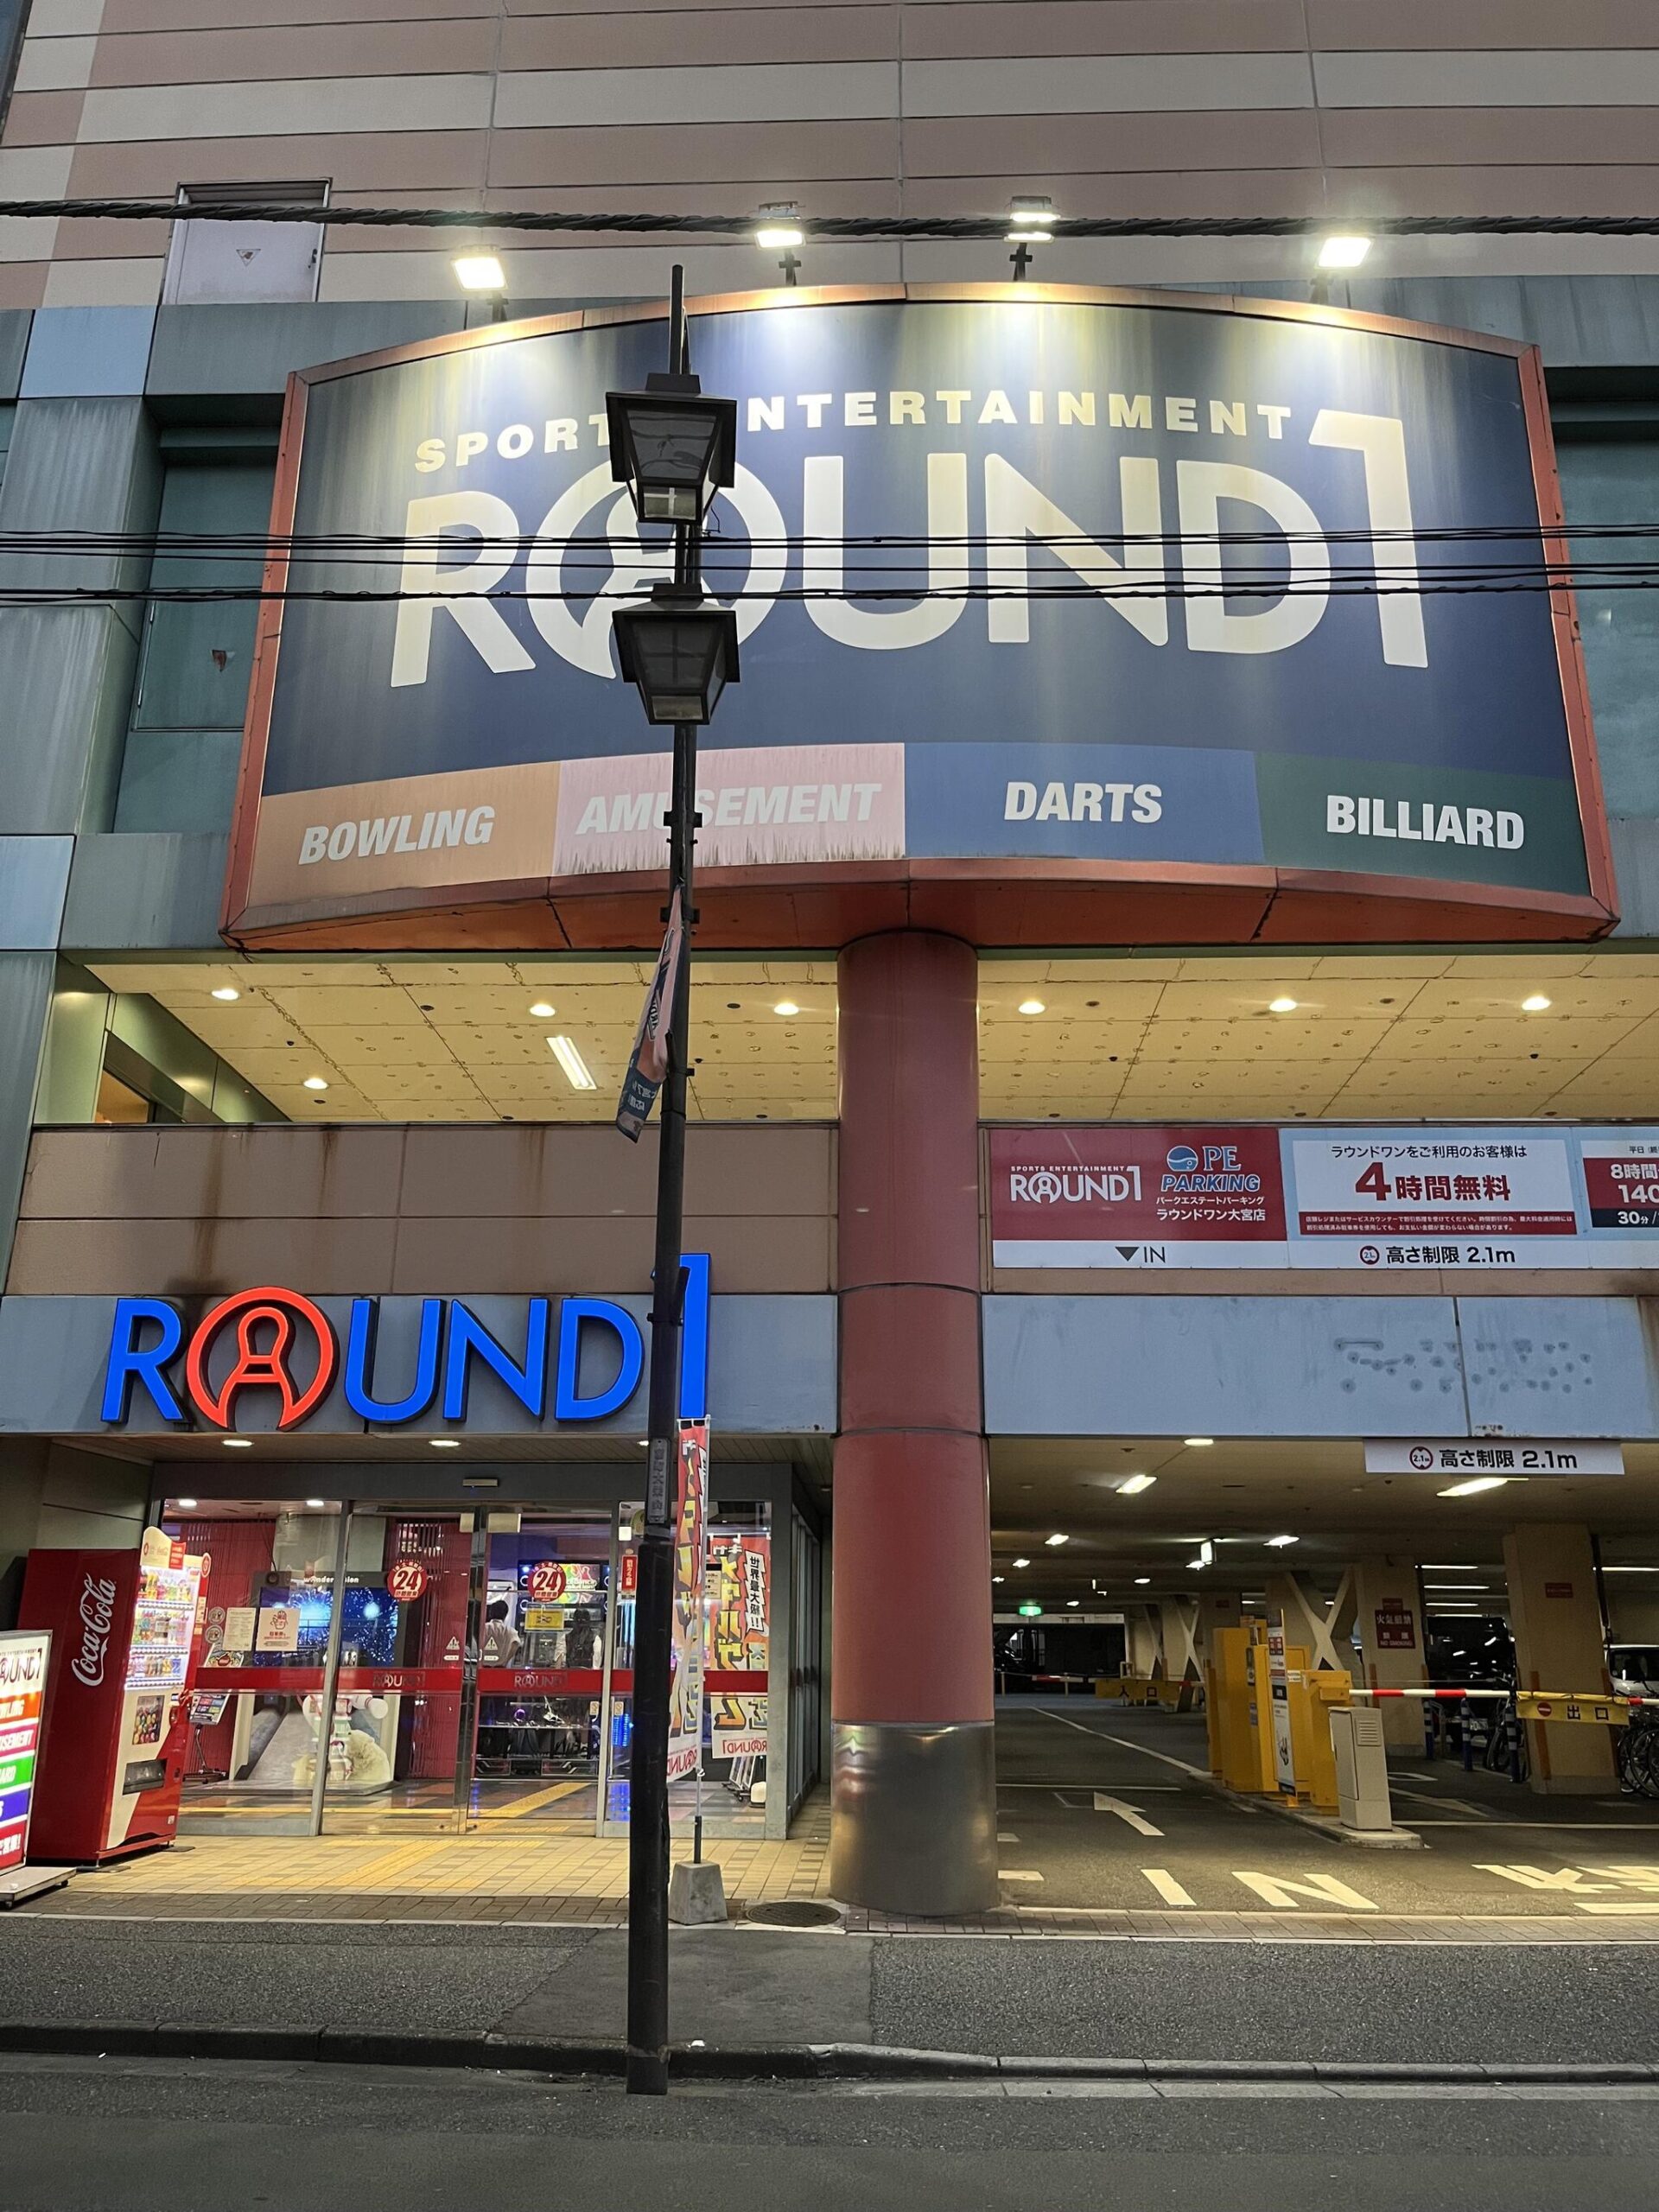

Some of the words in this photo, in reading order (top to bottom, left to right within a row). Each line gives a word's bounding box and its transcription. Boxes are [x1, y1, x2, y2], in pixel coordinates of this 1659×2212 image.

[415, 414, 610, 474] SPORT
[747, 391, 1292, 441] NTERTAINMENT
[391, 409, 1429, 688] ROUND1
[1004, 781, 1163, 824] DARTS
[1326, 794, 1525, 850] BILLIARD
[298, 805, 496, 866] BOWLING
[1203, 1146, 1242, 1171] PE
[1332, 1145, 1528, 1158] ラウンドワンをご利用のお客様は
[1355, 1161, 1511, 1201] 4時間無料
[1611, 1163, 1659, 1179] 8時間
[1010, 1166, 1142, 1204] ROUND1
[1160, 1173, 1261, 1192] PARKING
[1156, 1196, 1264, 1205] パークエステートパーキング
[1156, 1209, 1266, 1222] ラウンドワン大宮店
[1144, 1247, 1166, 1263] IN
[1386, 1246, 1460, 1264] 高さ制限
[1466, 1247, 1516, 1262] 2.1m
[101, 1253, 711, 1433] ROUND1
[1439, 1449, 1515, 1468] 高さ制限
[1522, 1450, 1578, 1469] 2.1m
[395, 1570, 419, 1590] 24
[535, 1571, 558, 1591] 24
[1118, 1686, 1157, 1698] 入口
[1567, 1704, 1609, 1720] 出口
[1141, 1868, 1380, 1910] IN
